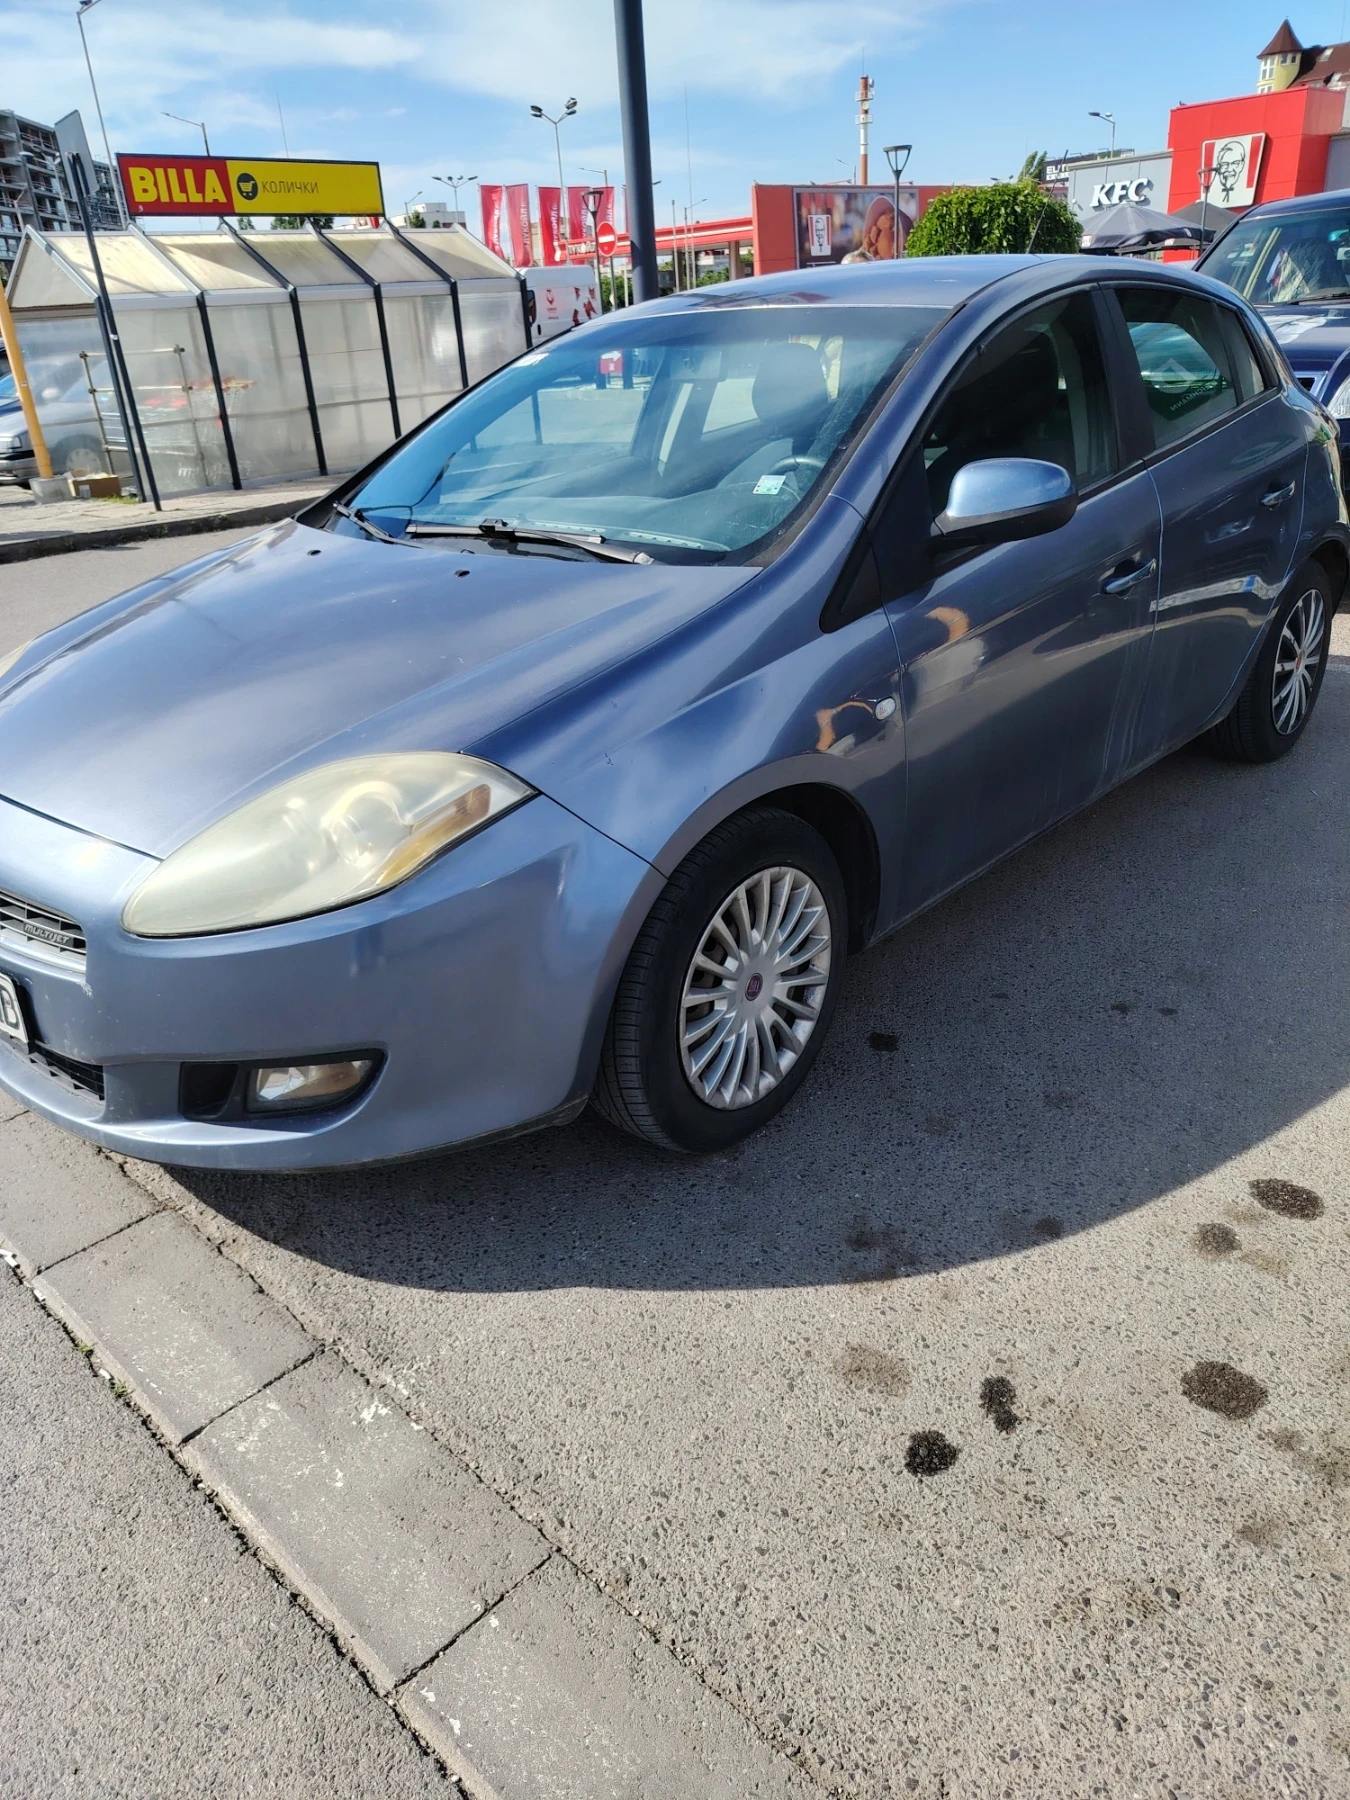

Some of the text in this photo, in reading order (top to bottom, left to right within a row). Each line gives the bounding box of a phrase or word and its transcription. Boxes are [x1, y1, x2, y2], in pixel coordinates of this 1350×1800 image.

[128, 167, 227, 203] BILLA
[261, 180, 319, 194] КОЛИЧКИ
[1089, 178, 1149, 207] KFC
[519, 209, 530, 245] ЛУКОЙЛ
[24, 923, 71, 945] MULTIJET
